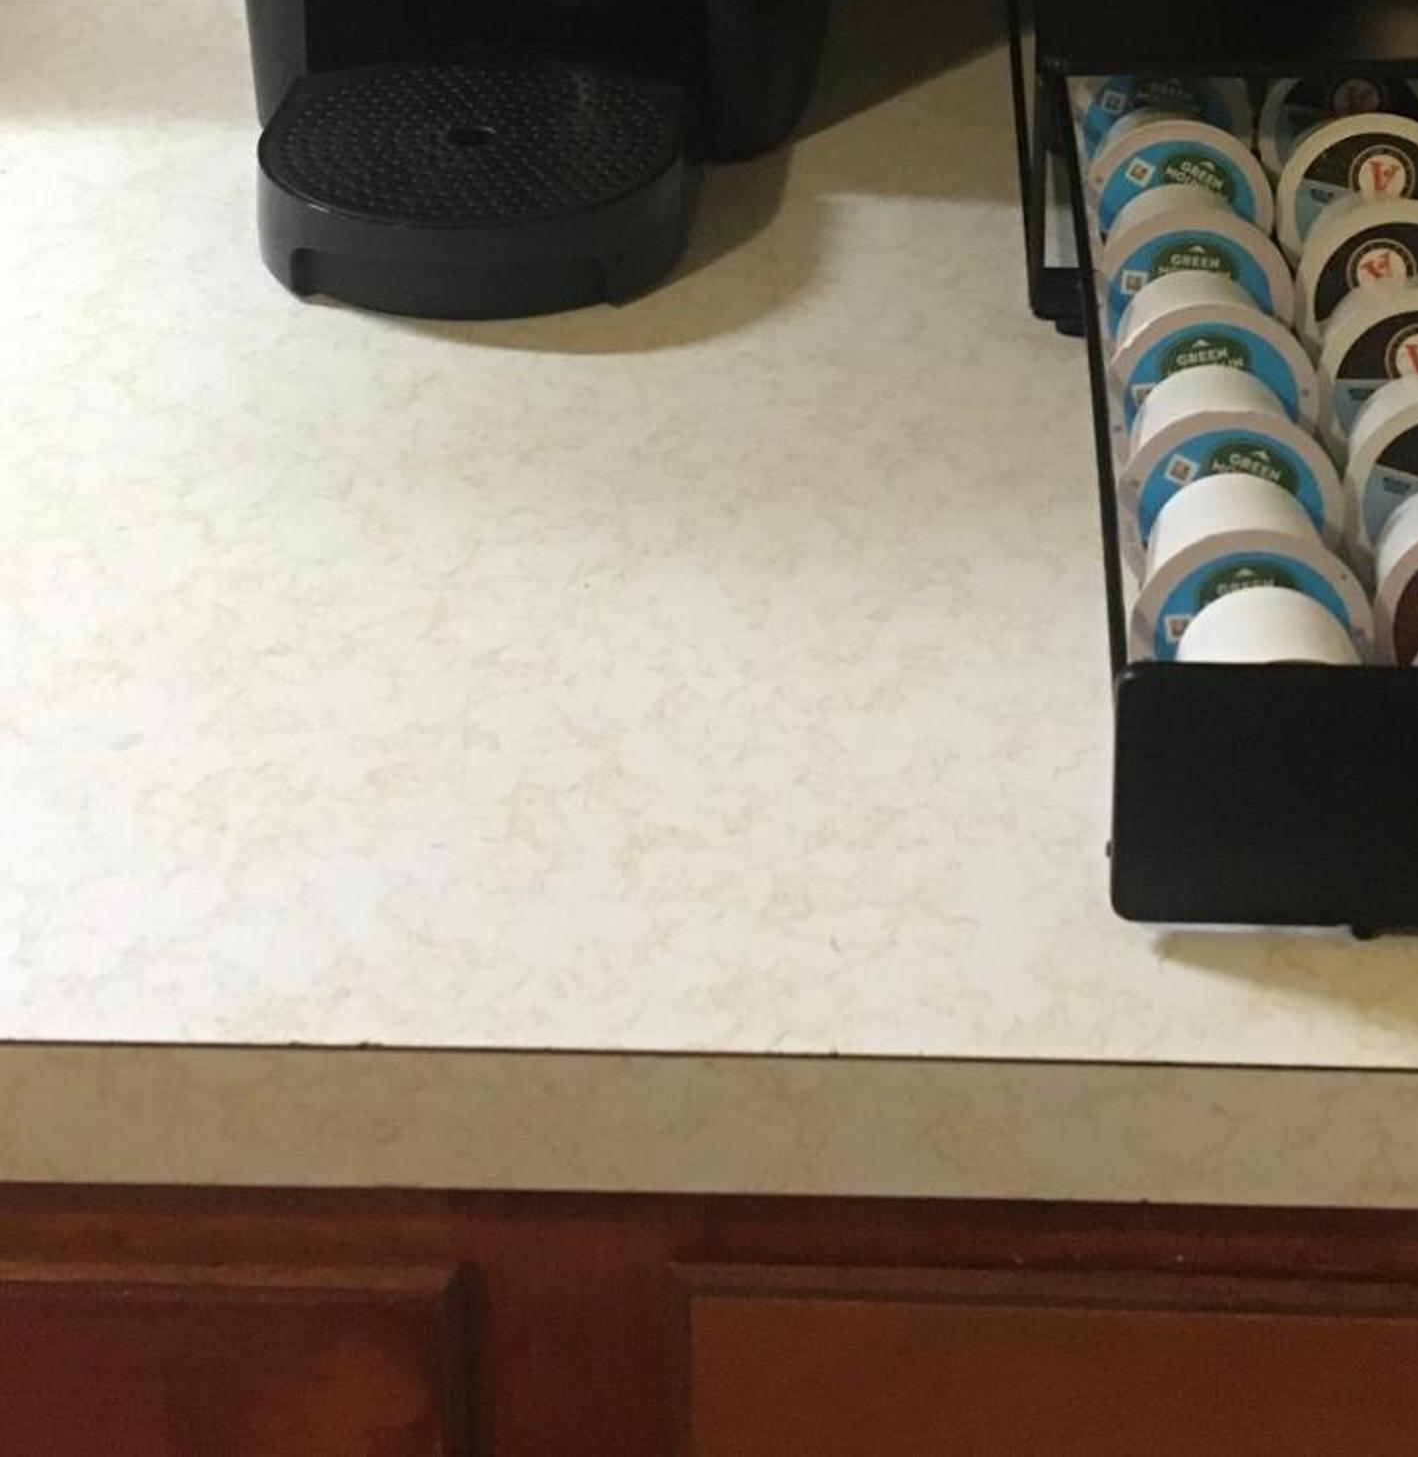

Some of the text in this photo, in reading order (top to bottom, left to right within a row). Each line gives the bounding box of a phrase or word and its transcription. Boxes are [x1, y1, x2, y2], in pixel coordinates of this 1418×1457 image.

[1180, 160, 1225, 191] GREEN
[1170, 253, 1221, 269] GREEN
[1176, 347, 1228, 366] GREEN
[1229, 453, 1282, 481] GREEN
